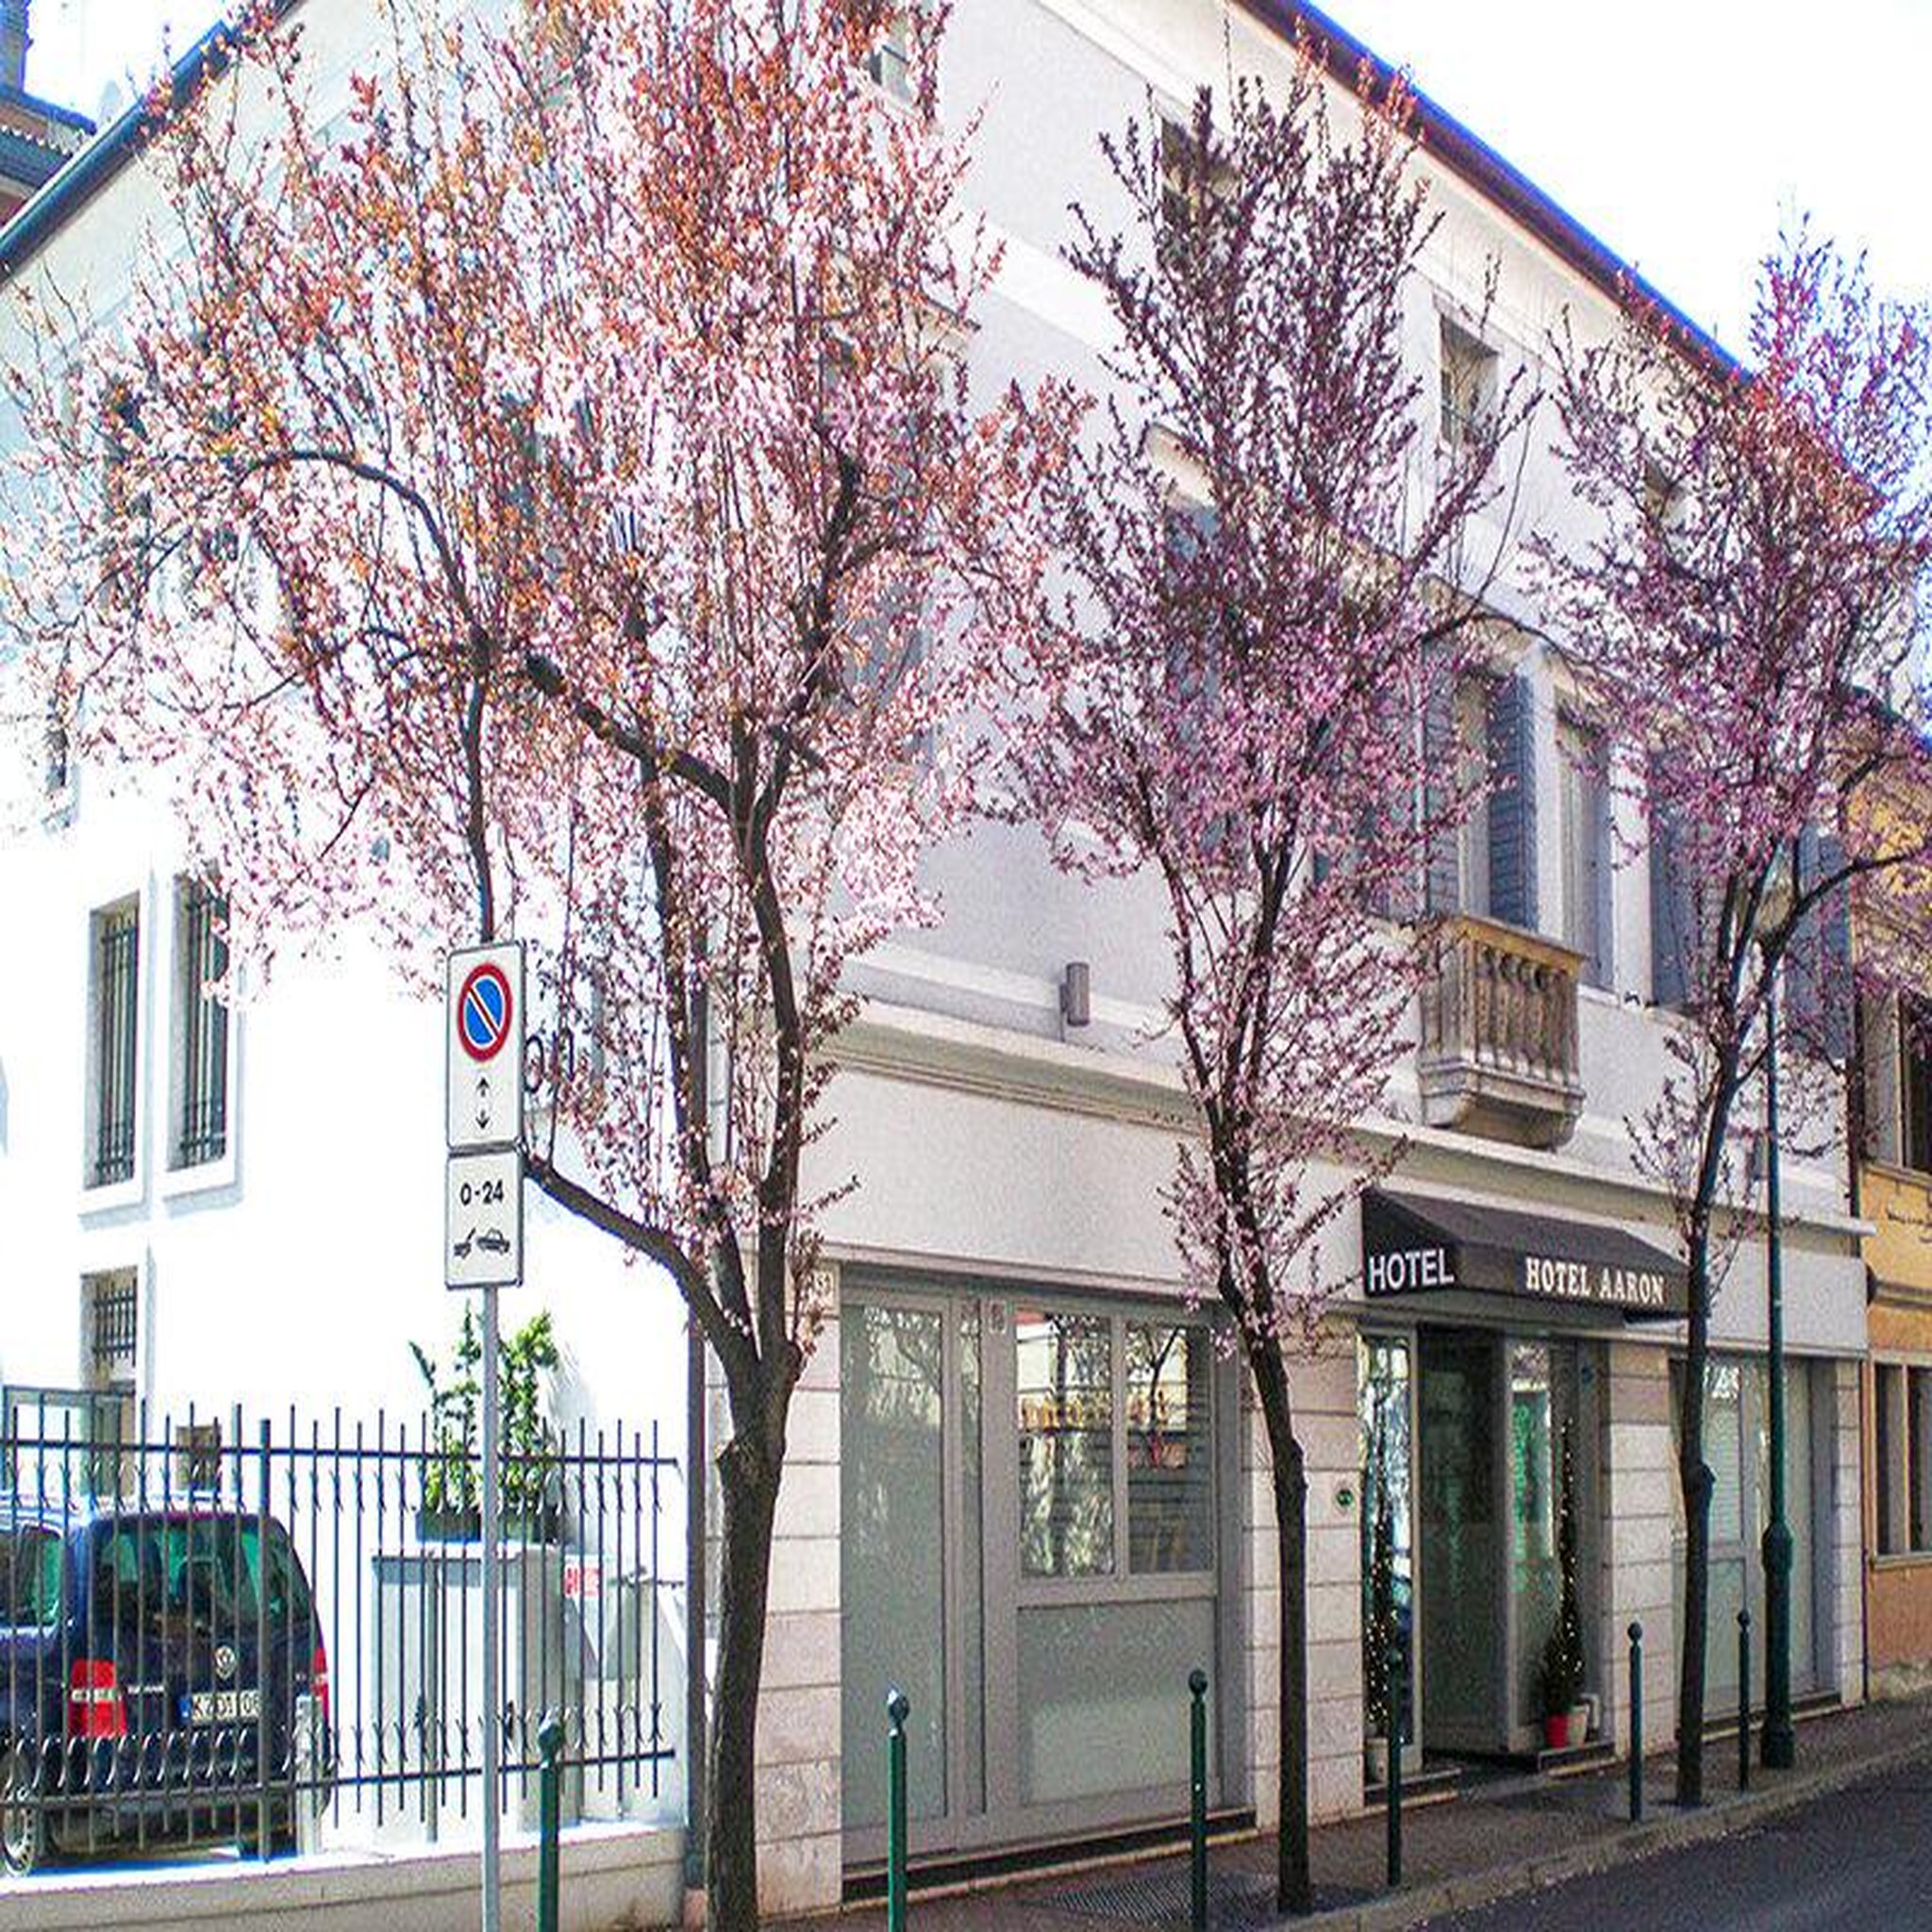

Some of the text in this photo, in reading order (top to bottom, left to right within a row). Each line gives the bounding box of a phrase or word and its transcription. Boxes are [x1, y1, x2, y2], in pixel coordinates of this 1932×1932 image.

[459, 1179, 504, 1207] 0-24
[1369, 1248, 1455, 1291] HOTEL
[1525, 1257, 1664, 1304] HOTEL AARON
